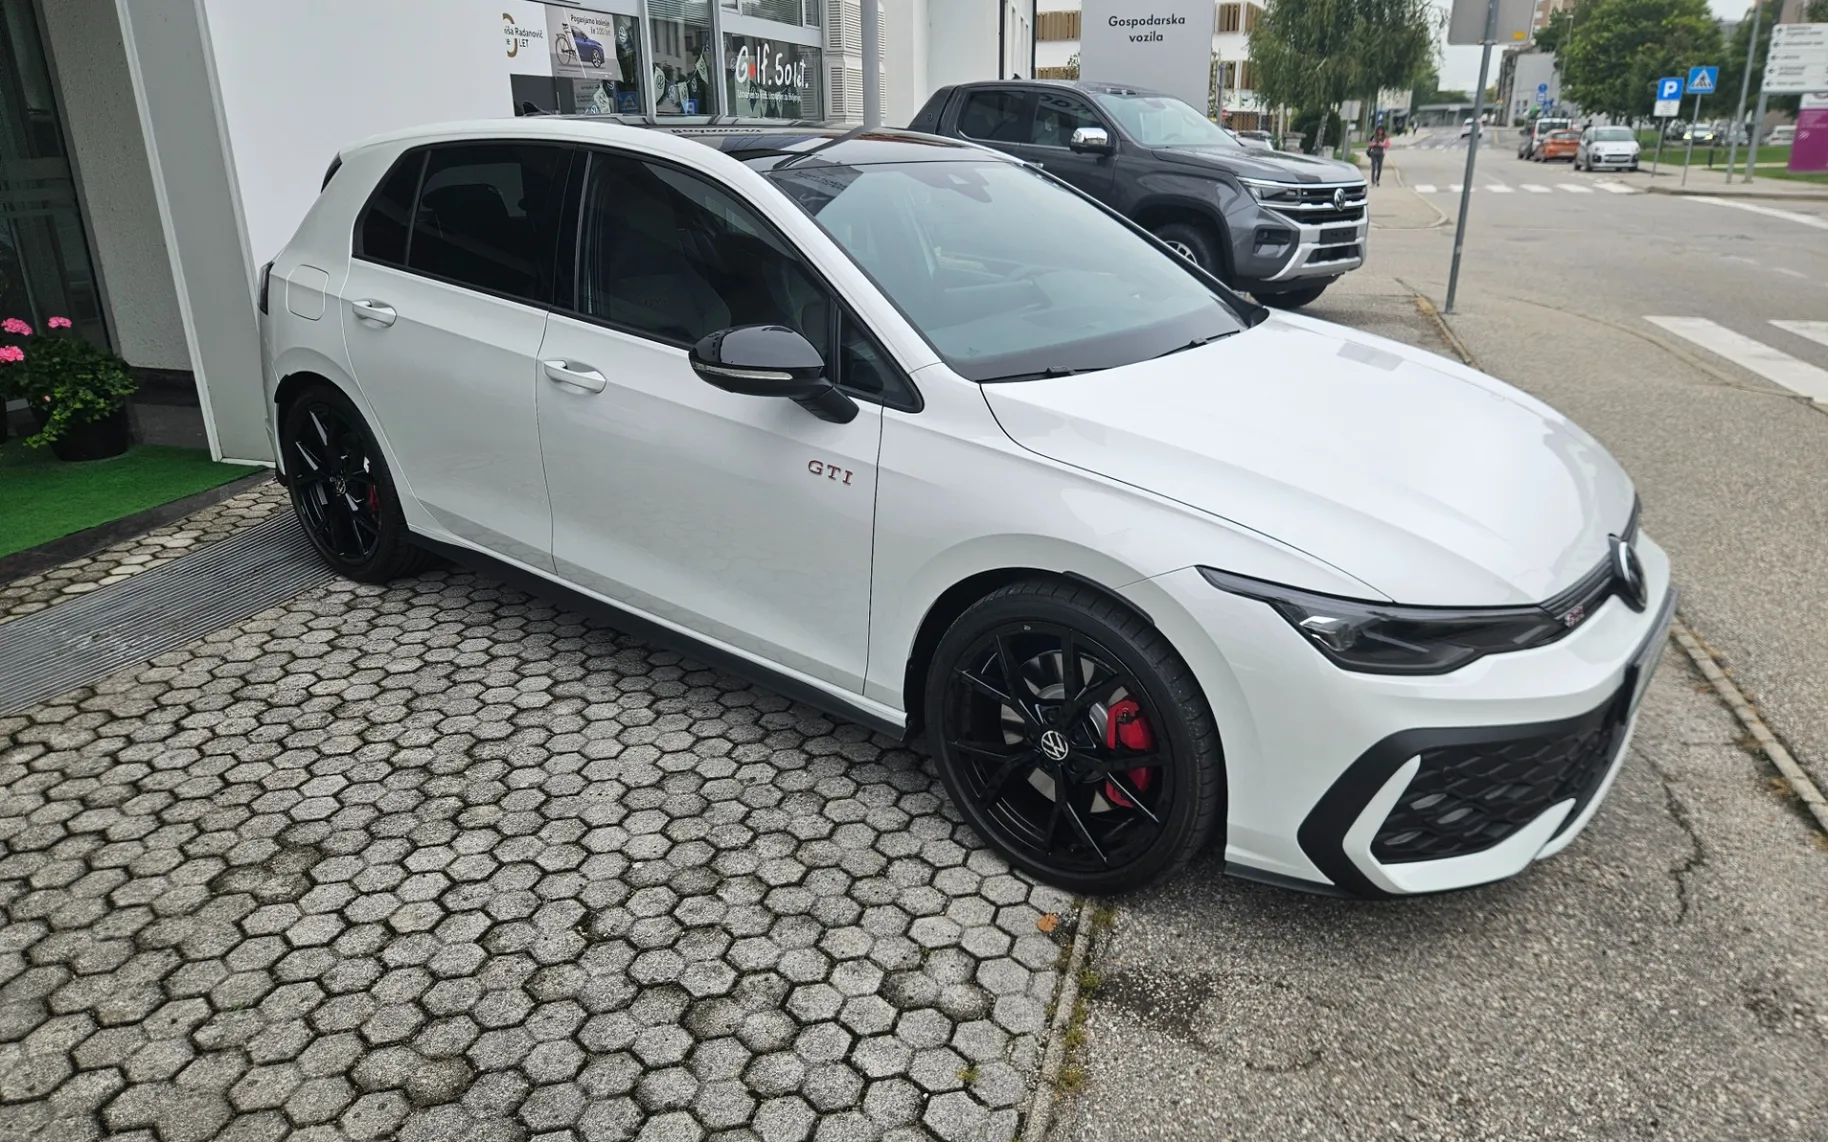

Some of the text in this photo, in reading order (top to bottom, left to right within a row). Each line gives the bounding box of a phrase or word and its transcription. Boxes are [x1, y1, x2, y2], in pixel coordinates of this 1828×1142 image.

[1108, 13, 1185, 28] Gospodarska
[1129, 31, 1163, 42] vozila
[1663, 81, 1678, 98] P
[808, 460, 853, 486] GTI
